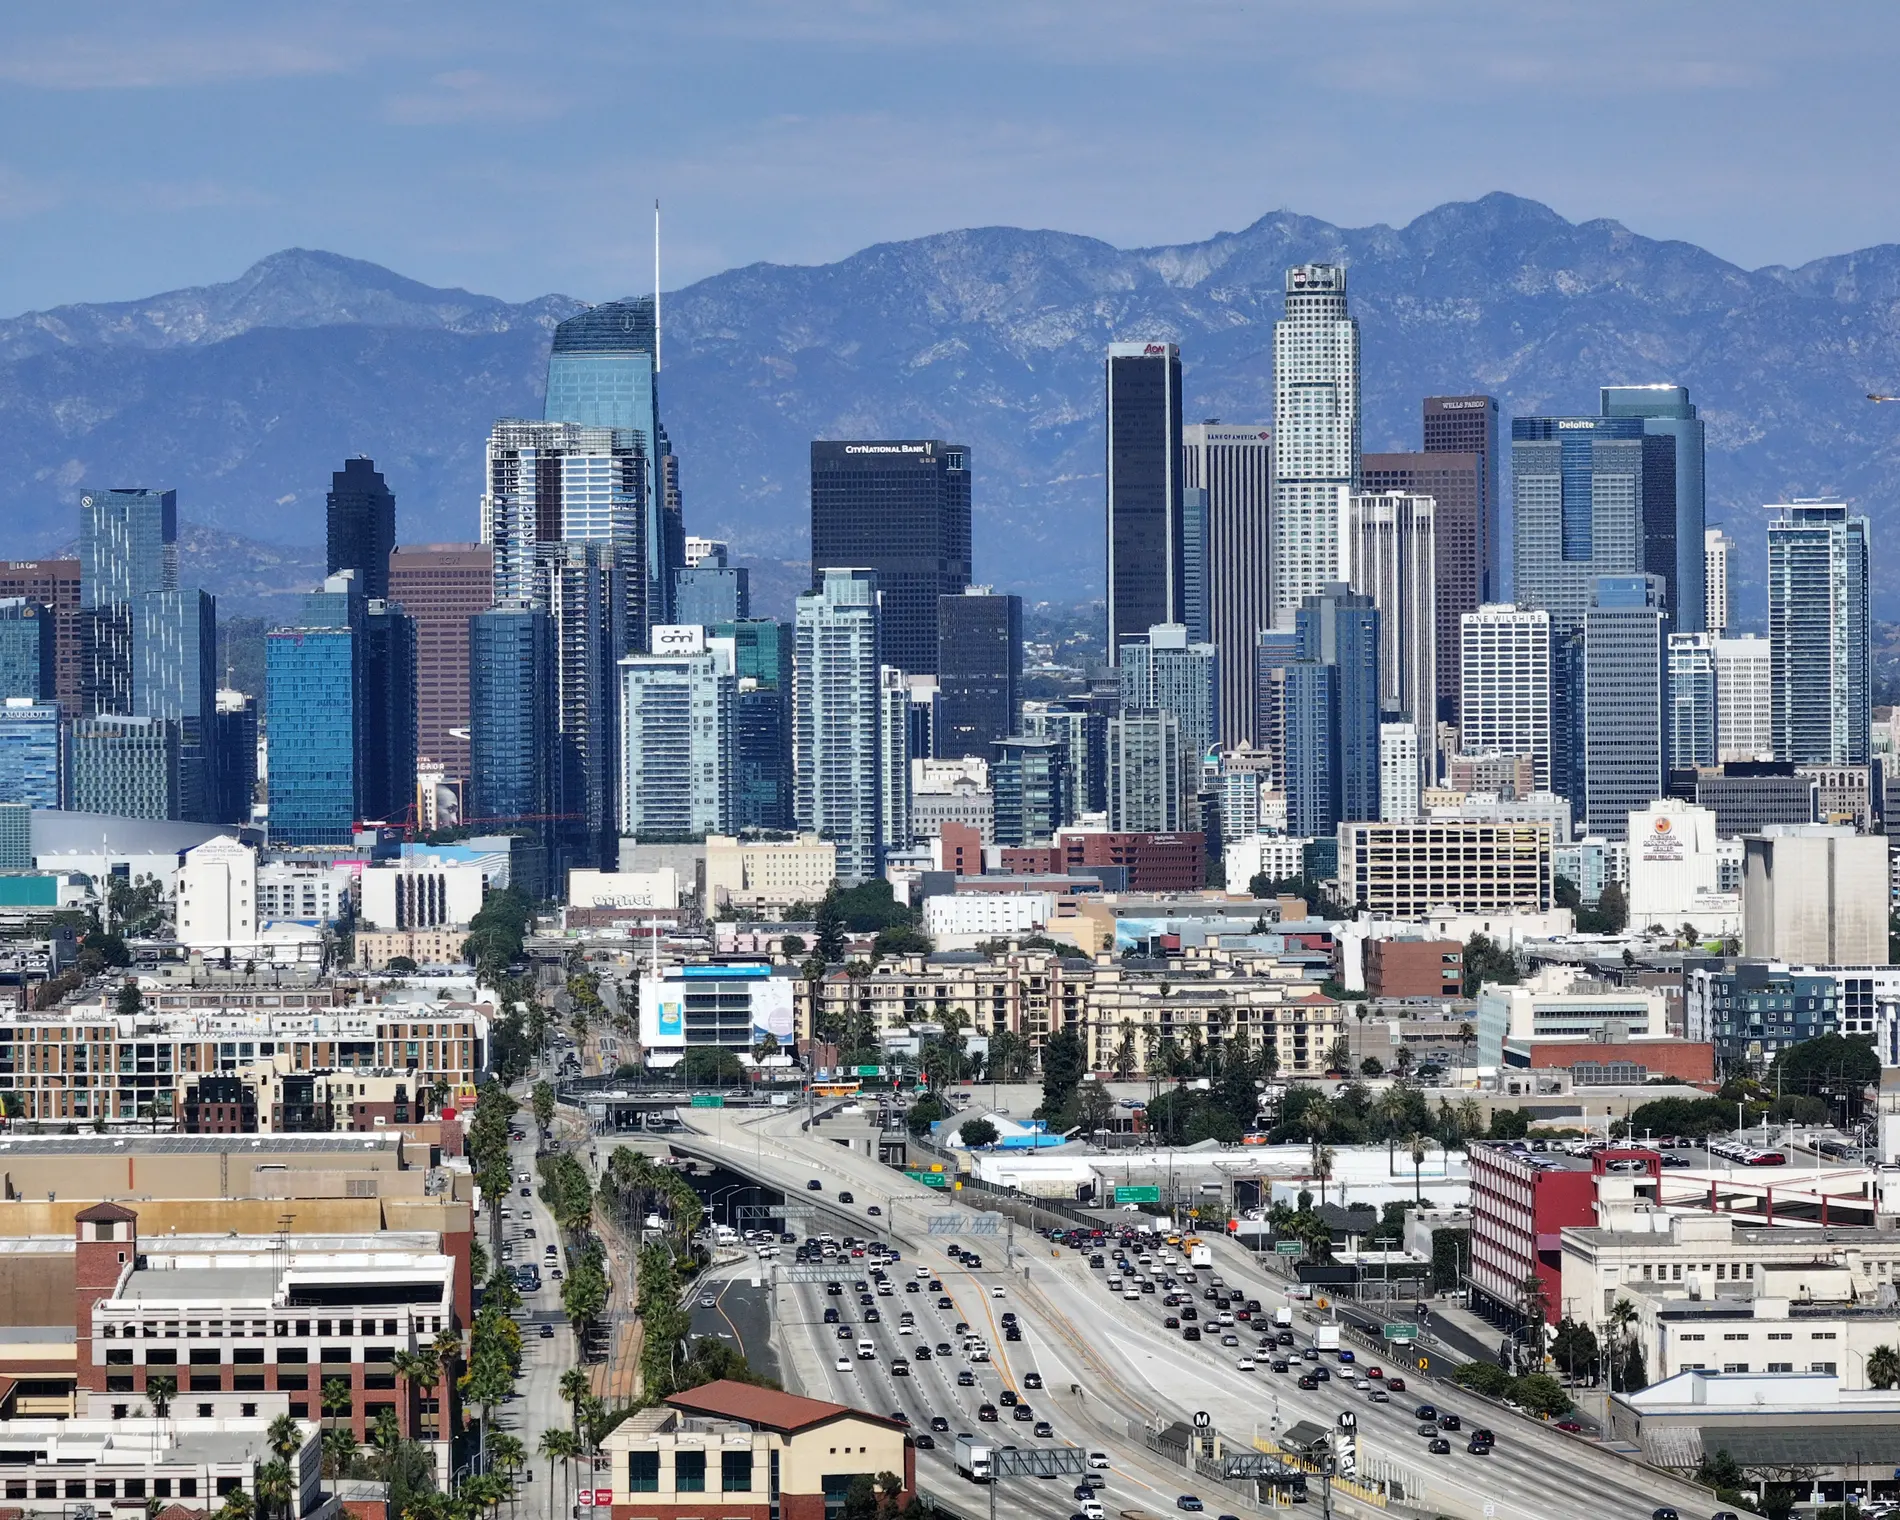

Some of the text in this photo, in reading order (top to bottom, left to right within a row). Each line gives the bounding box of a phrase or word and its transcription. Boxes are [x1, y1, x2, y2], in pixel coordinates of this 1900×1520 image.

[1559, 421, 1595, 429] Deloitte
[901, 445, 925, 453] BANK
[1468, 615, 1542, 623] ONE WILSHIRE
[1196, 1413, 1208, 1426] M
[1342, 1413, 1354, 1426] M
